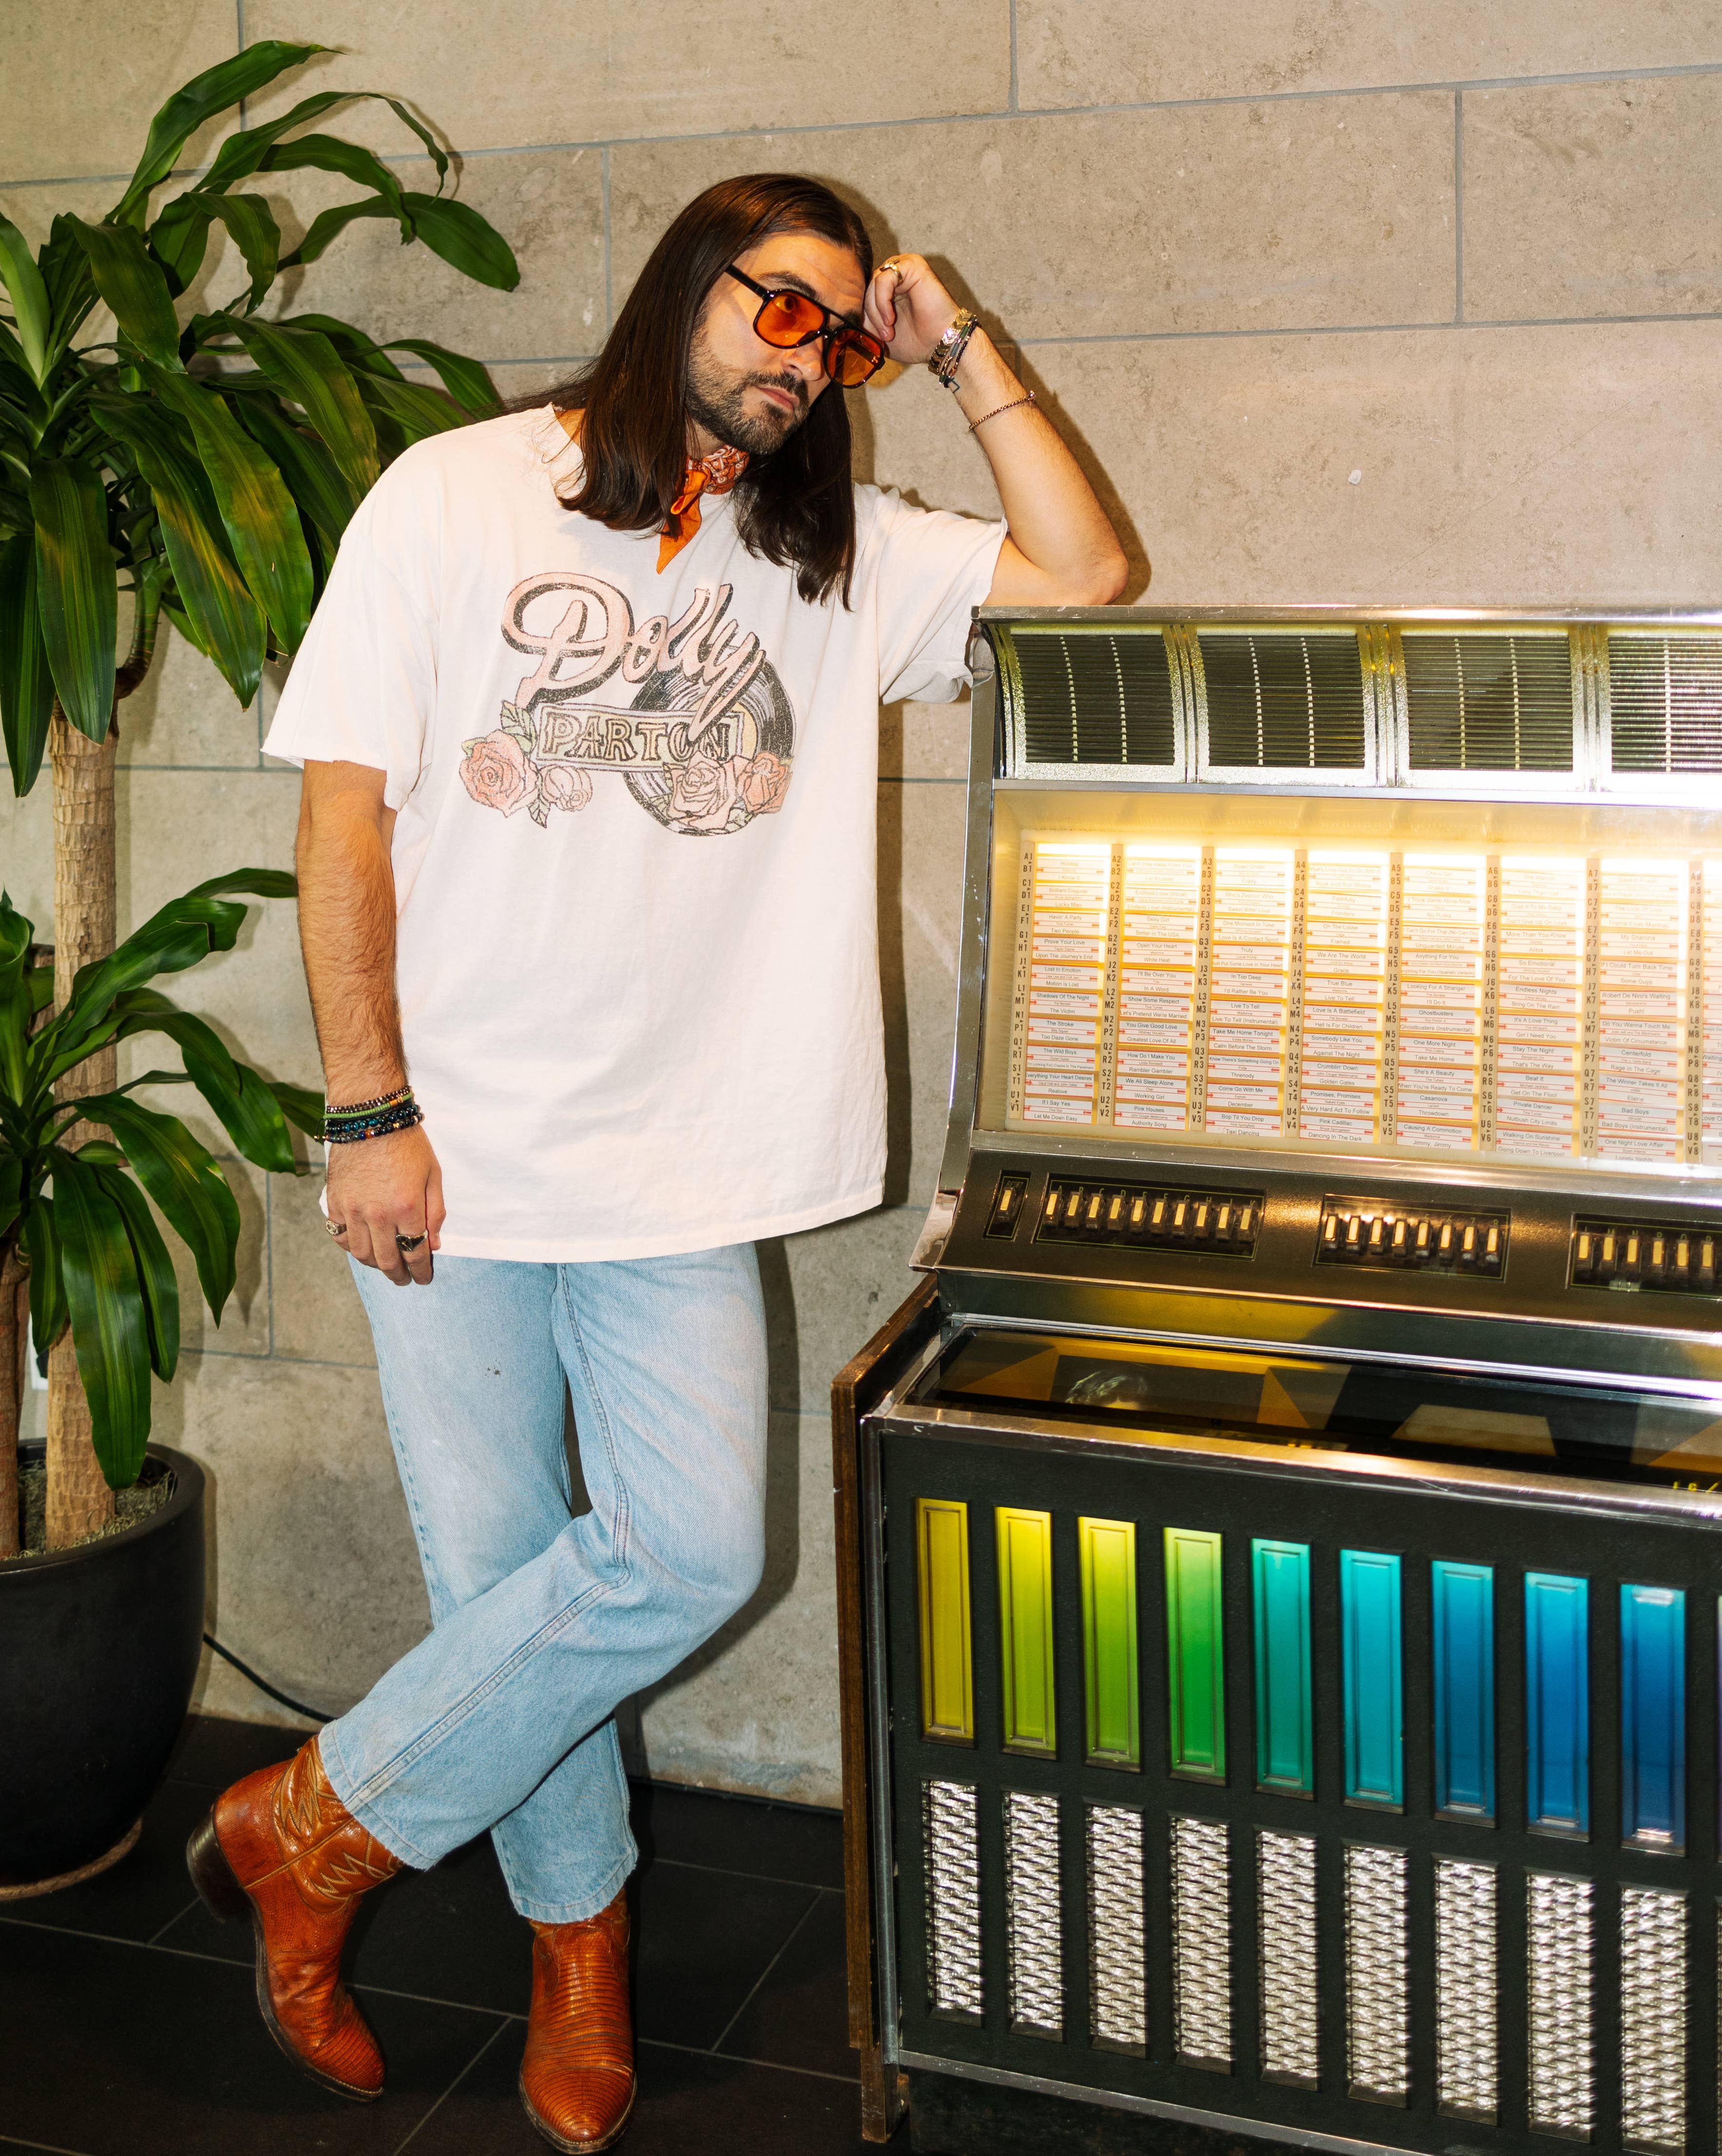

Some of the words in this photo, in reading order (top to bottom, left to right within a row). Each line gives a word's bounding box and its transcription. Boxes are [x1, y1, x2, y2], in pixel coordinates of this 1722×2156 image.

[501, 572, 766, 745] Dolly
[542, 712, 731, 761] PARTON
[1586, 996, 1596, 1004] K7
[1013, 1050, 1021, 1059] R1
[1584, 1054, 1595, 1062] P7
[1384, 1072, 1394, 1080] R5
[1482, 1105, 1492, 1114] T6
[1584, 1111, 1594, 1119] T7
